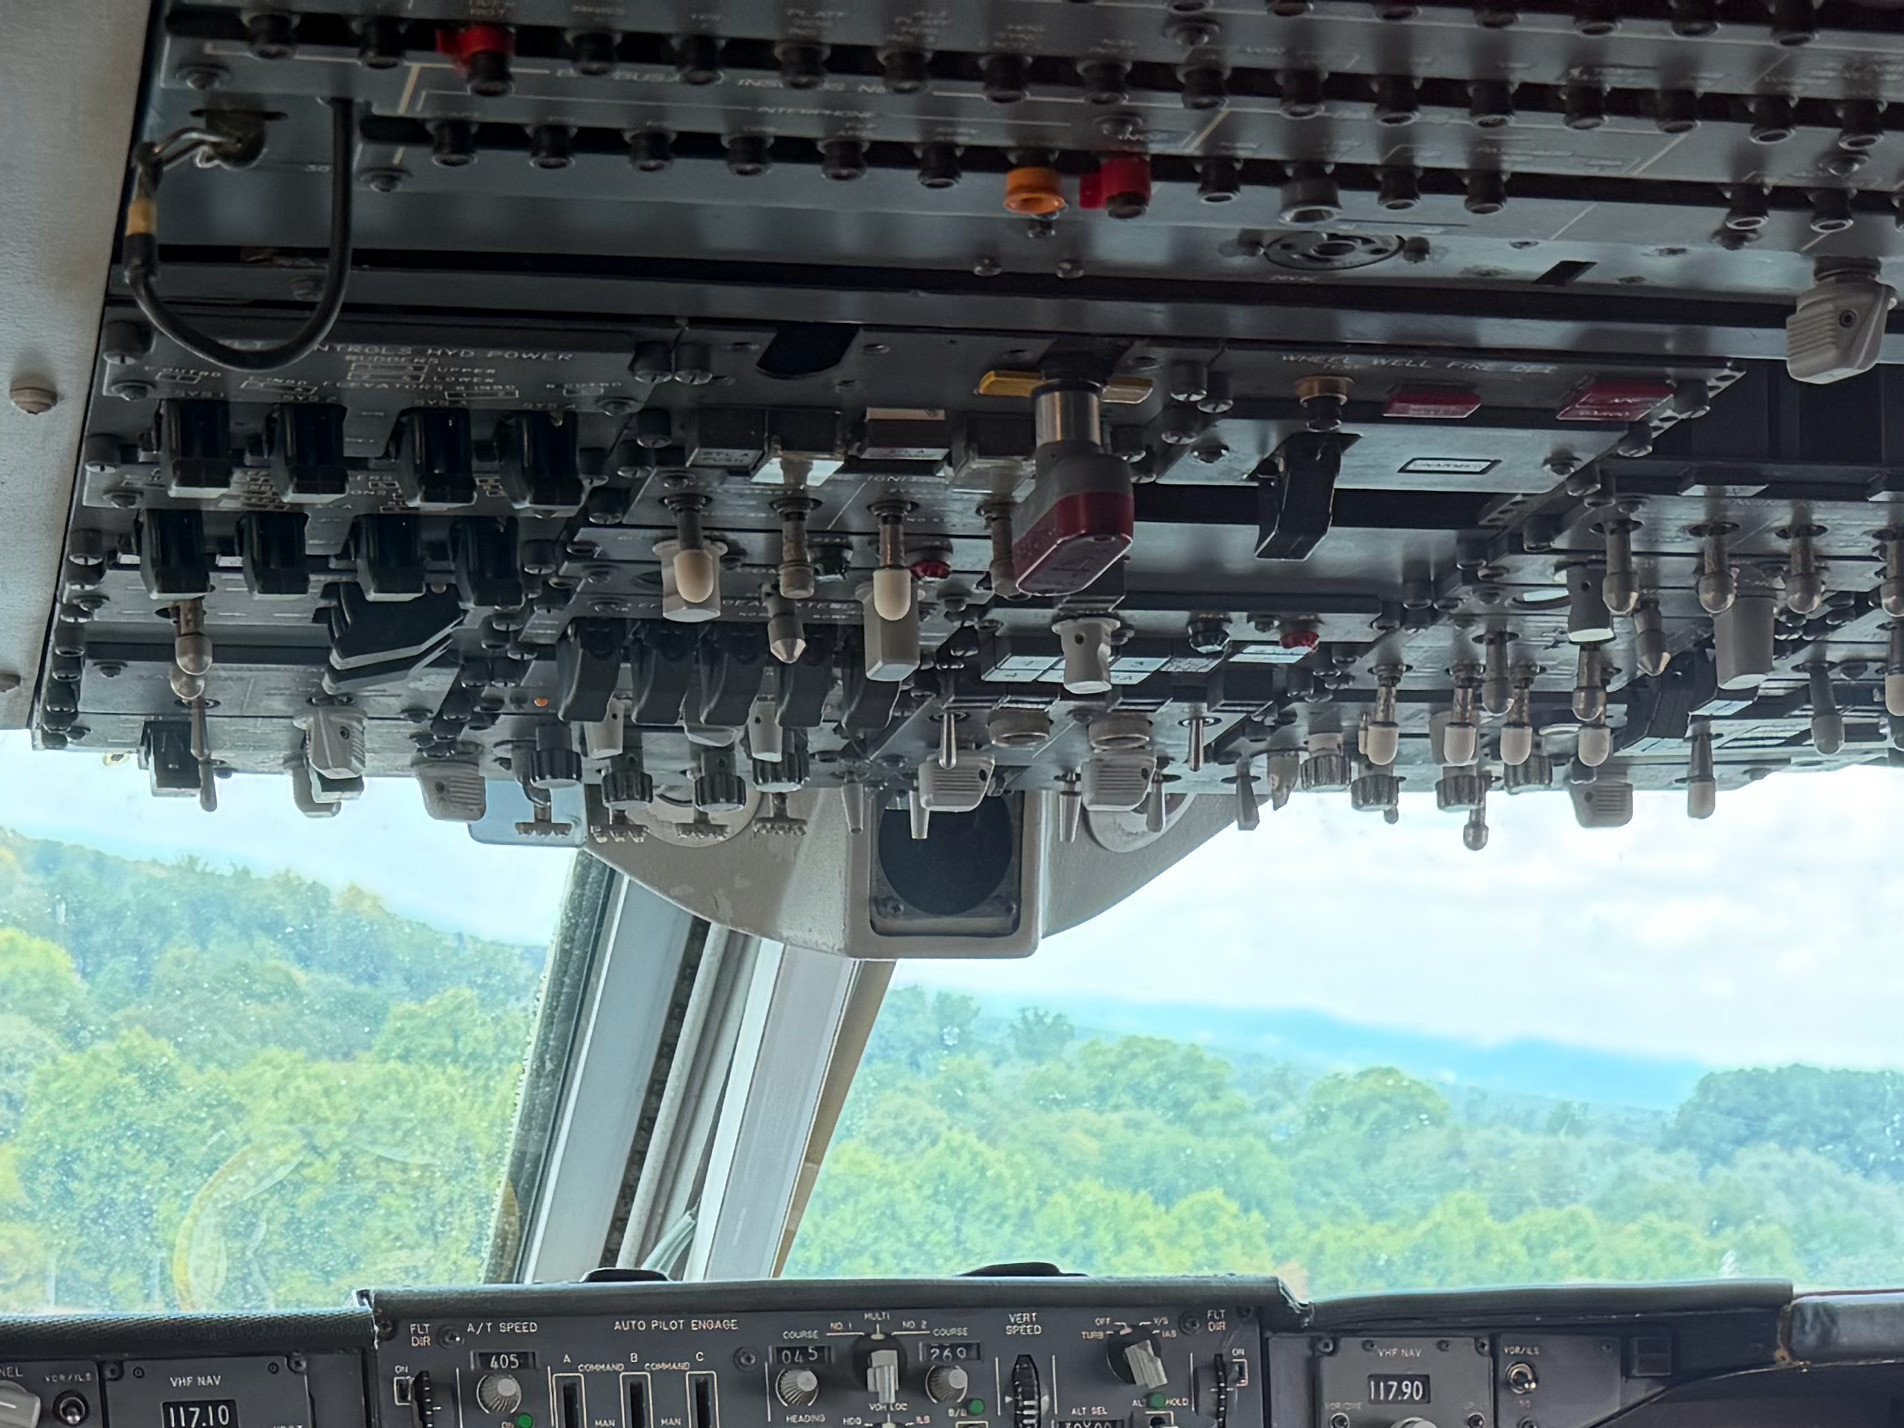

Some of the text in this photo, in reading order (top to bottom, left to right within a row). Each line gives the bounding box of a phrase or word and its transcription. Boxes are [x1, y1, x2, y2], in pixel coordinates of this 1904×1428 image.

[1009, 1313, 1036, 1323] VERT
[1207, 1310, 1225, 1320] FLT
[410, 1324, 429, 1334] FLT
[467, 1322, 537, 1333] A/T SPEED
[614, 1320, 738, 1331] AUTO PILOT ENGAGE
[1006, 1324, 1041, 1335] SPEED
[783, 1331, 818, 1339] COURSE
[411, 1337, 431, 1347] DIR
[490, 1355, 519, 1368] 405
[564, 1354, 570, 1363] A
[696, 1352, 704, 1361] C
[170, 1375, 221, 1387] VHF NAV
[1369, 1380, 1423, 1402] 117.90
[168, 1405, 229, 1427] 117.10
